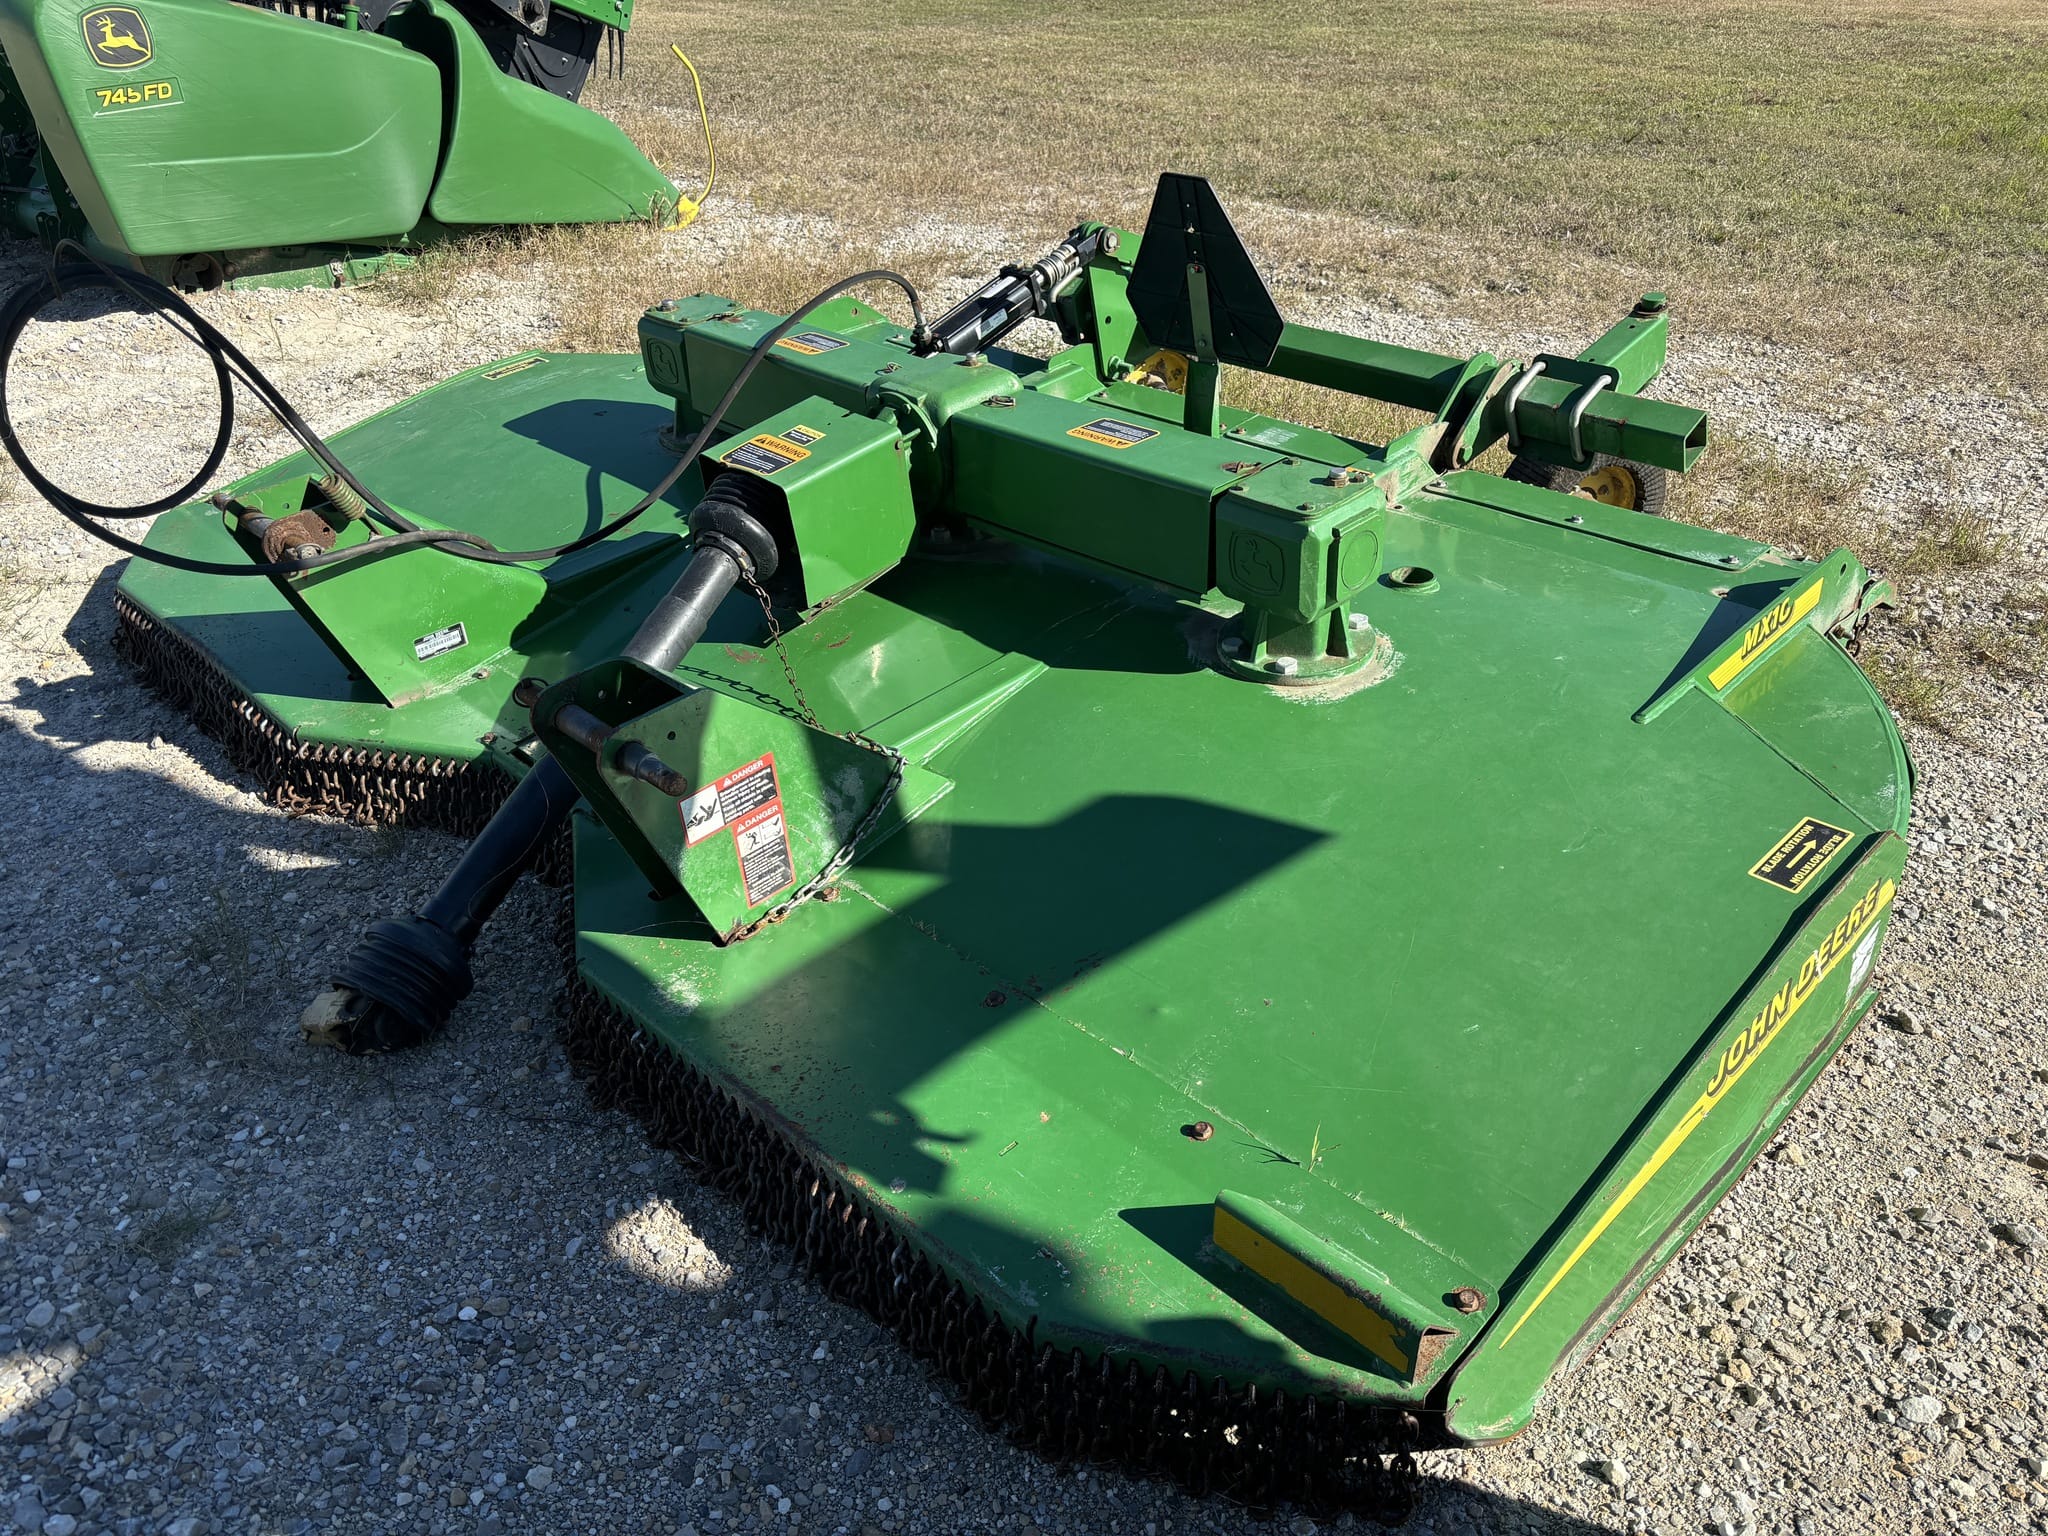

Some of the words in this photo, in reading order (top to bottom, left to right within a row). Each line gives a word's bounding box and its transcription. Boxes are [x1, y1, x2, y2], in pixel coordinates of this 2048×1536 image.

[95, 82, 173, 107] 745FD
[766, 439, 807, 459] WARNING
[731, 759, 764, 782] DANGER
[745, 805, 779, 828] DANGER
[1761, 849, 1787, 873] BLADE
[1780, 824, 1815, 854] ROTATION
[1818, 834, 1843, 856] BLADE
[1790, 853, 1825, 885] ROTATION
[1706, 977, 1793, 1097] JOHN
[1796, 877, 1882, 1000] DEERE
